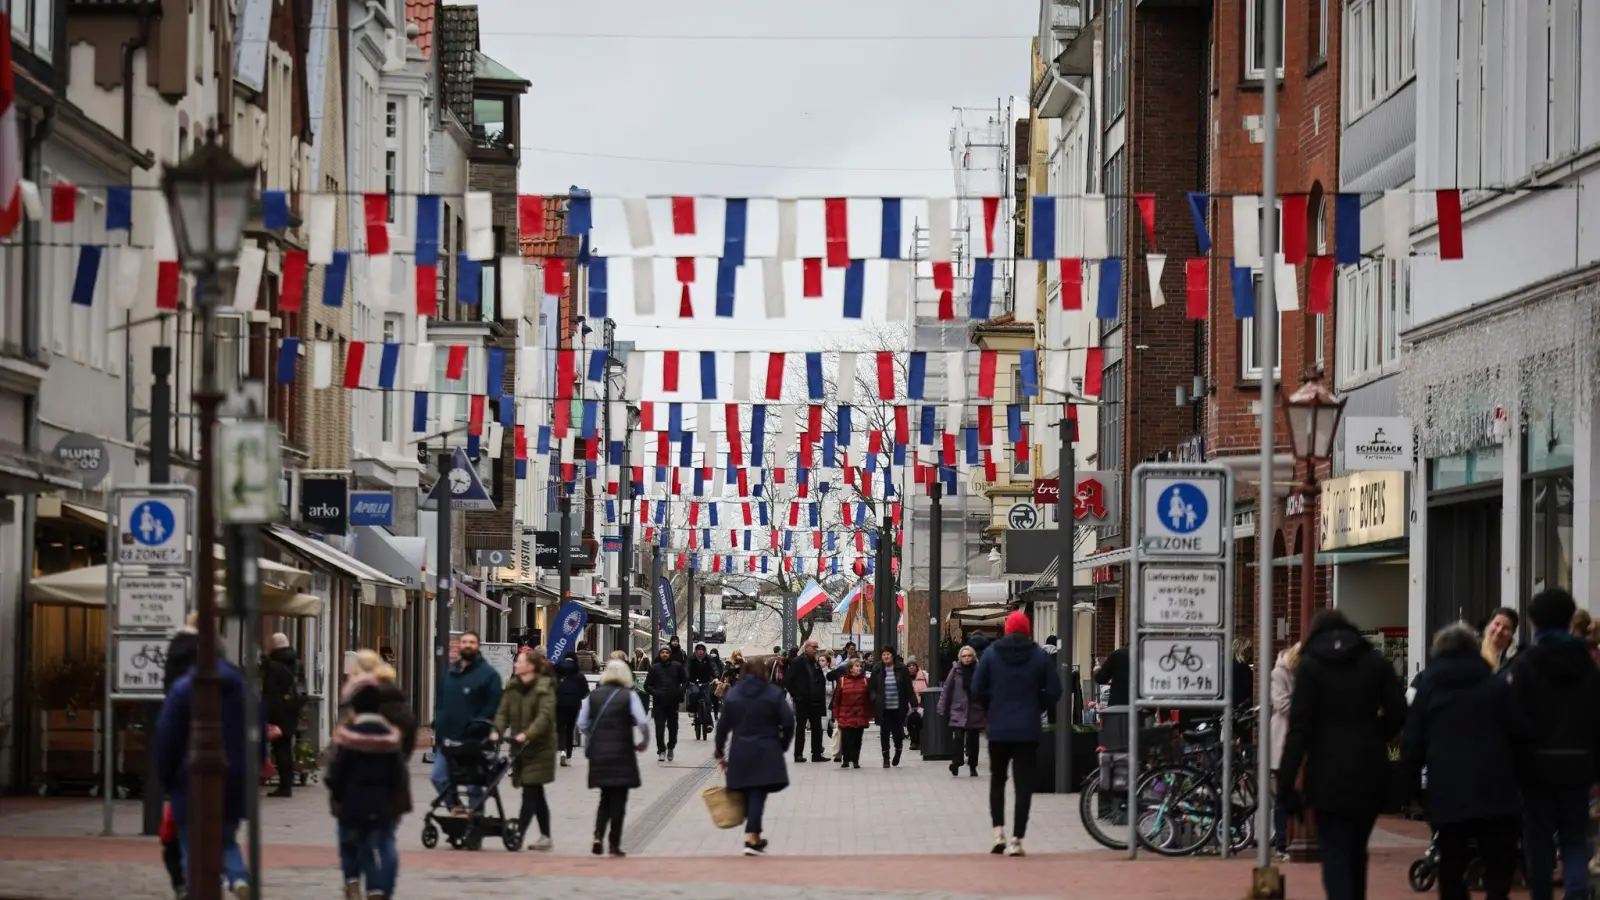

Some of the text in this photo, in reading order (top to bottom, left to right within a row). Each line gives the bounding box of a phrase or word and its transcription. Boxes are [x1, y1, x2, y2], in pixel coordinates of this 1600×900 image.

[60, 448, 100, 459] BLUME
[308, 502, 339, 517] arko
[353, 501, 390, 513] APOLLO
[1164, 537, 1202, 550] ZONE
[520, 539, 530, 579] AKUSTIK
[1150, 675, 1212, 690] frei 19-9h
